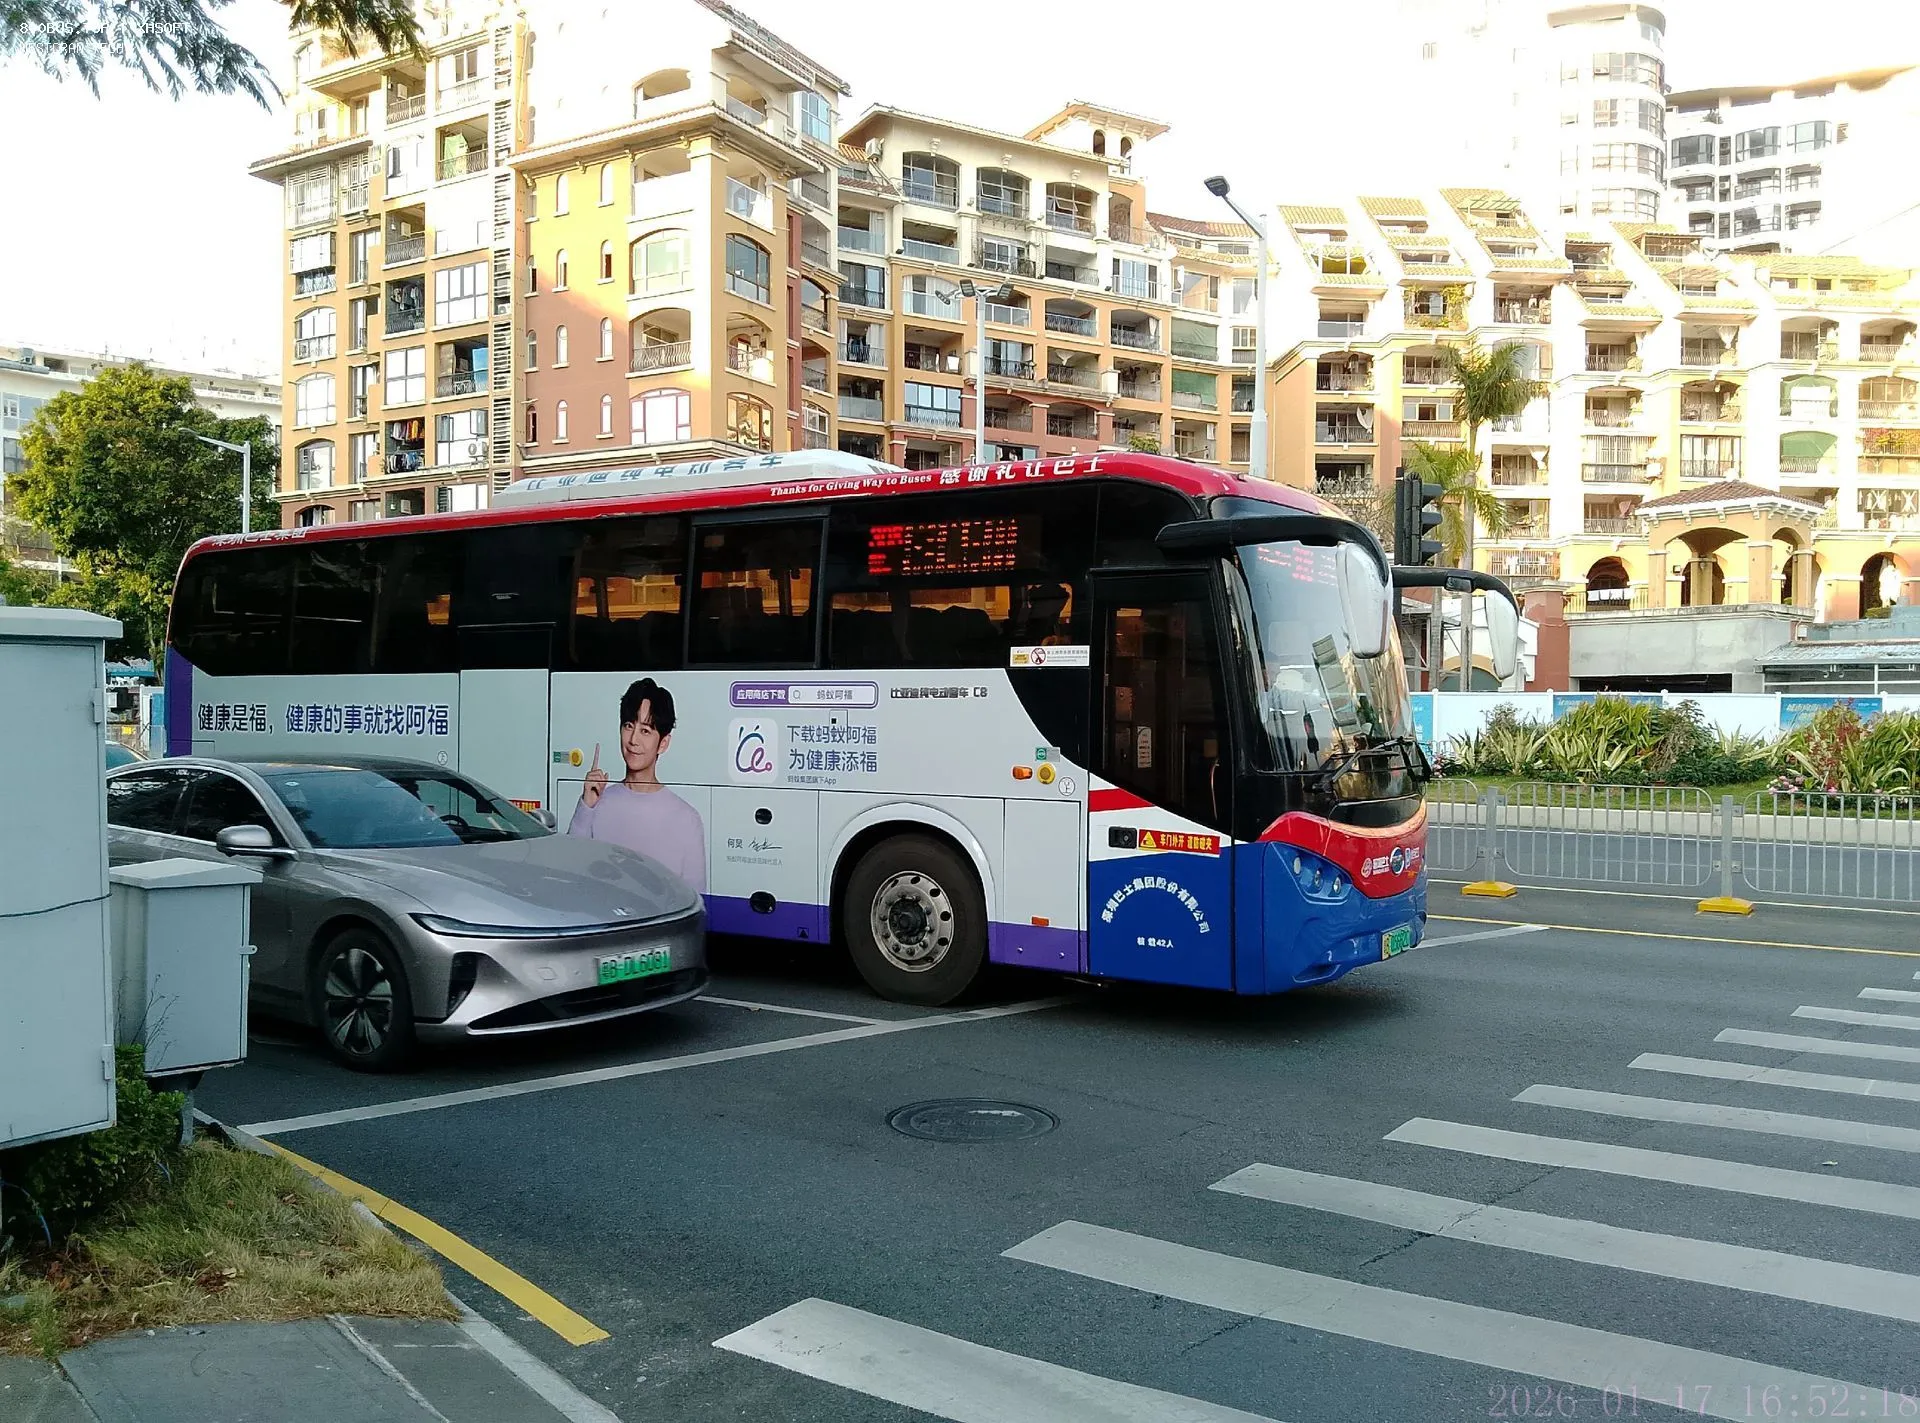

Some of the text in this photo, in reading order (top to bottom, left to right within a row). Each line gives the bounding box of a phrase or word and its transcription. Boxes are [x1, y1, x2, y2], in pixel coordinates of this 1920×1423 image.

[939, 456, 1105, 485] 感谢礼让巴士
[769, 473, 932, 497] Thanks for Giving Way to Buses
[737, 689, 786, 700] 应用商店下载
[816, 689, 853, 700] 蚂蚁阿福
[973, 686, 988, 698] C8
[786, 724, 878, 745] 下载蚂蚁阿福
[788, 747, 878, 773] 为健康添福
[1101, 876, 1211, 934] 深圳巴士集团股份有限公司
